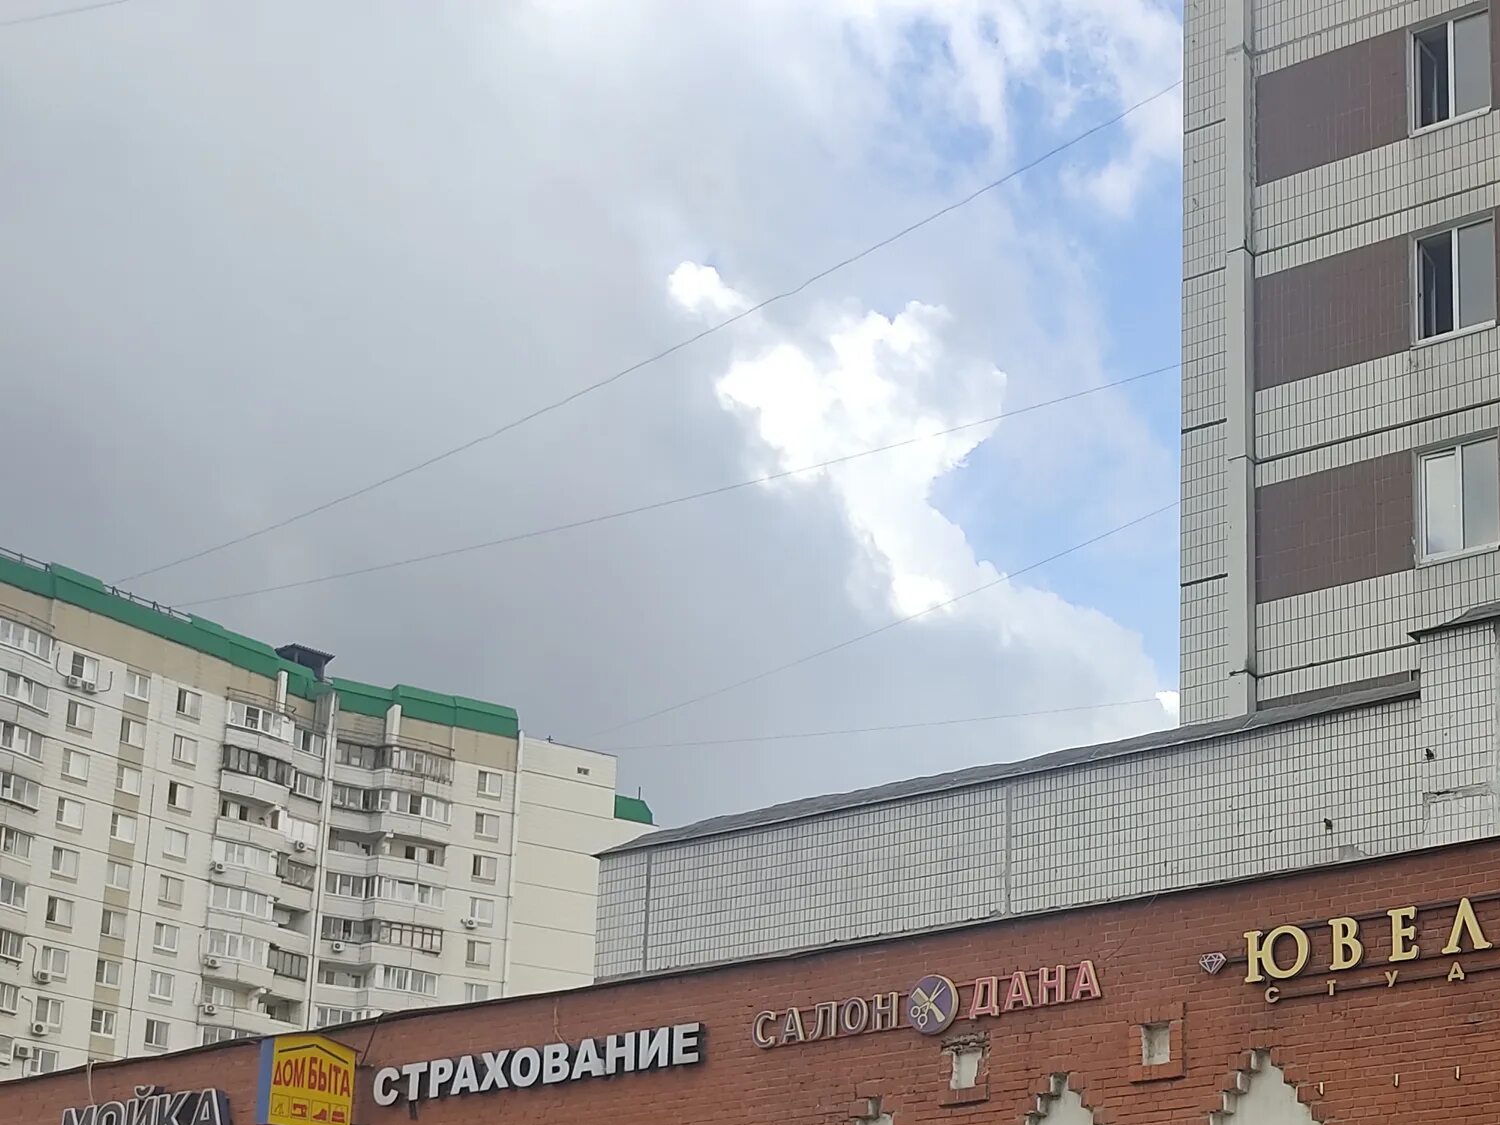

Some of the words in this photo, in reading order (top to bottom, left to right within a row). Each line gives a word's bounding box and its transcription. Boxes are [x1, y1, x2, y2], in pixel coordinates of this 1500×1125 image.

[751, 991, 900, 1049] САЛОН
[969, 959, 1103, 1020] ДАНА
[272, 1056, 307, 1089] ДОМ
[308, 1056, 351, 1098] БЫТА
[372, 1021, 701, 1107] СТРАХОВАНИЕ
